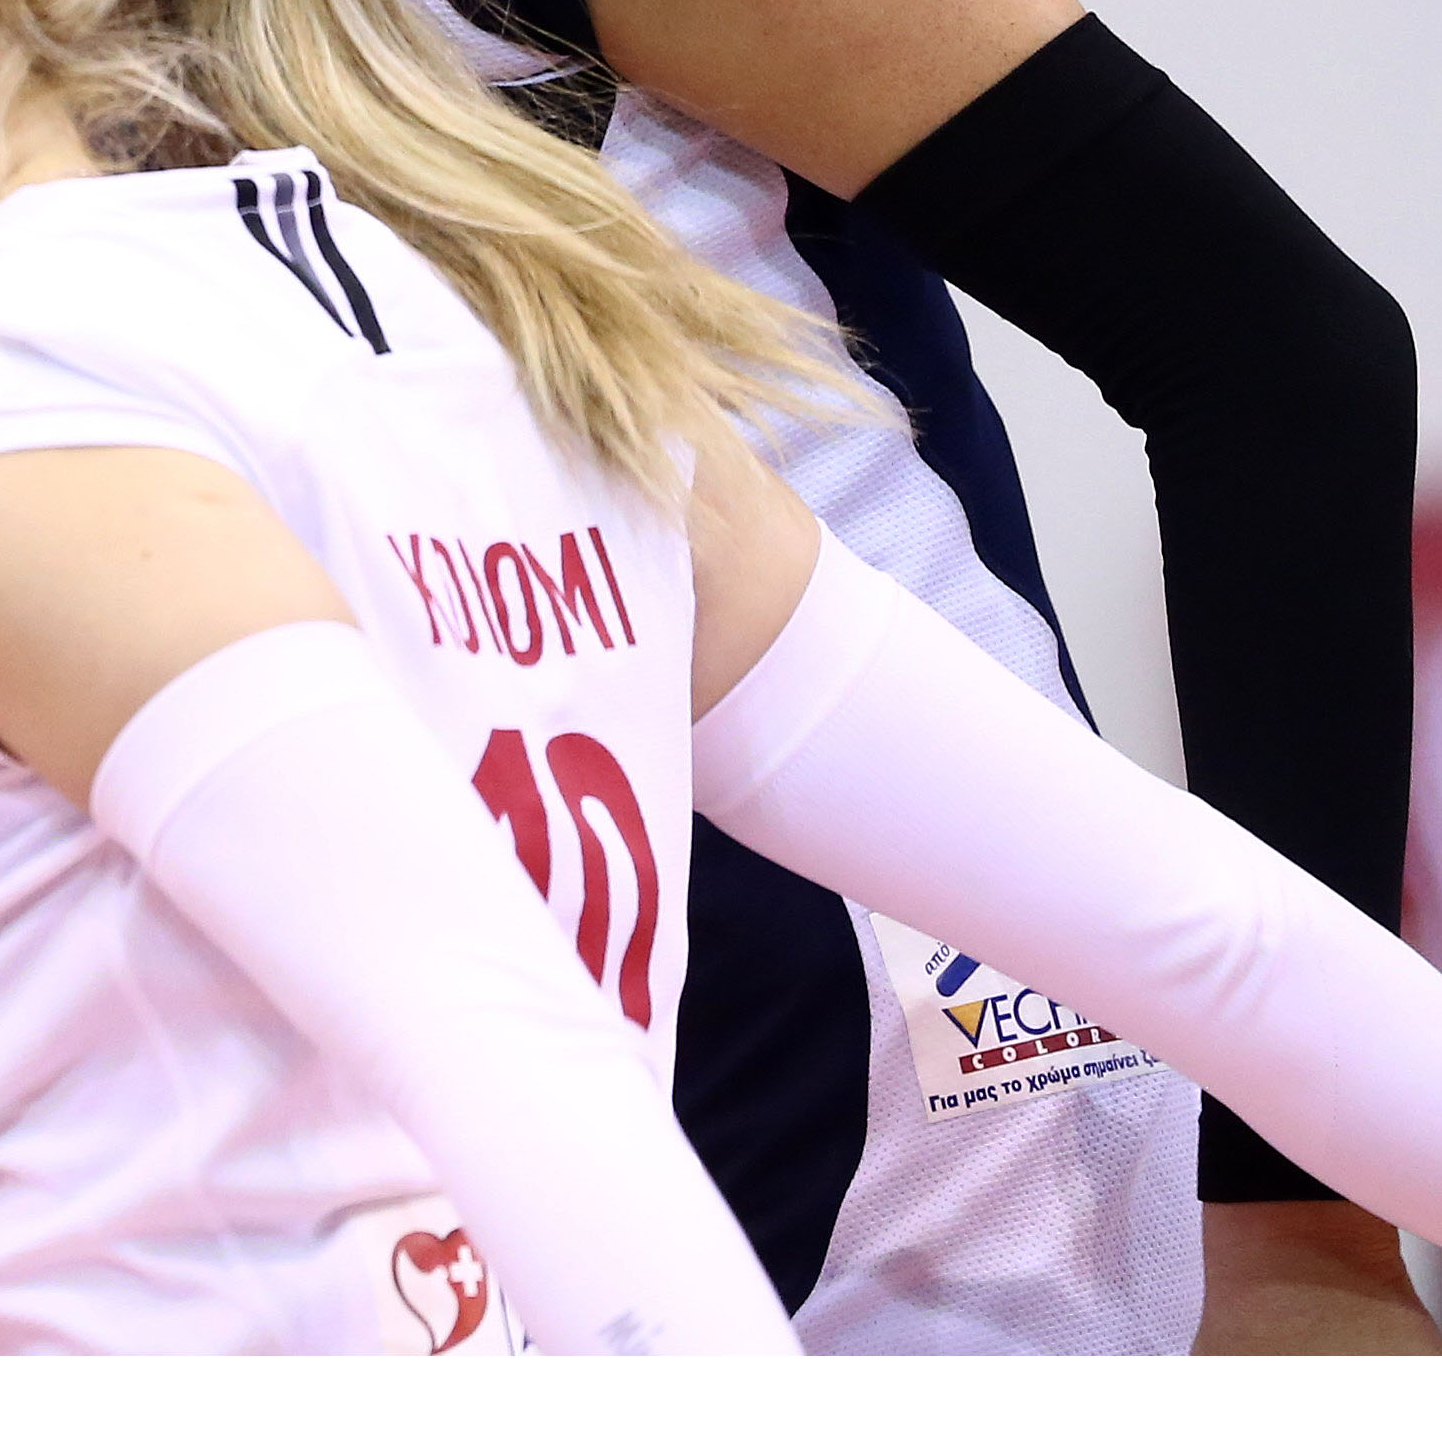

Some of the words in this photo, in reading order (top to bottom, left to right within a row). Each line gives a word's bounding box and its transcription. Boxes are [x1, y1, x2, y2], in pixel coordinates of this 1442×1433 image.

[471, 728, 660, 1033] 10
[928, 1093, 959, 1113] Για
[964, 1084, 999, 1107] μας
[1002, 1079, 1022, 1096] το
[1026, 1066, 1081, 1093] χρώμα
[1083, 1053, 1139, 1079] σημαίνει
